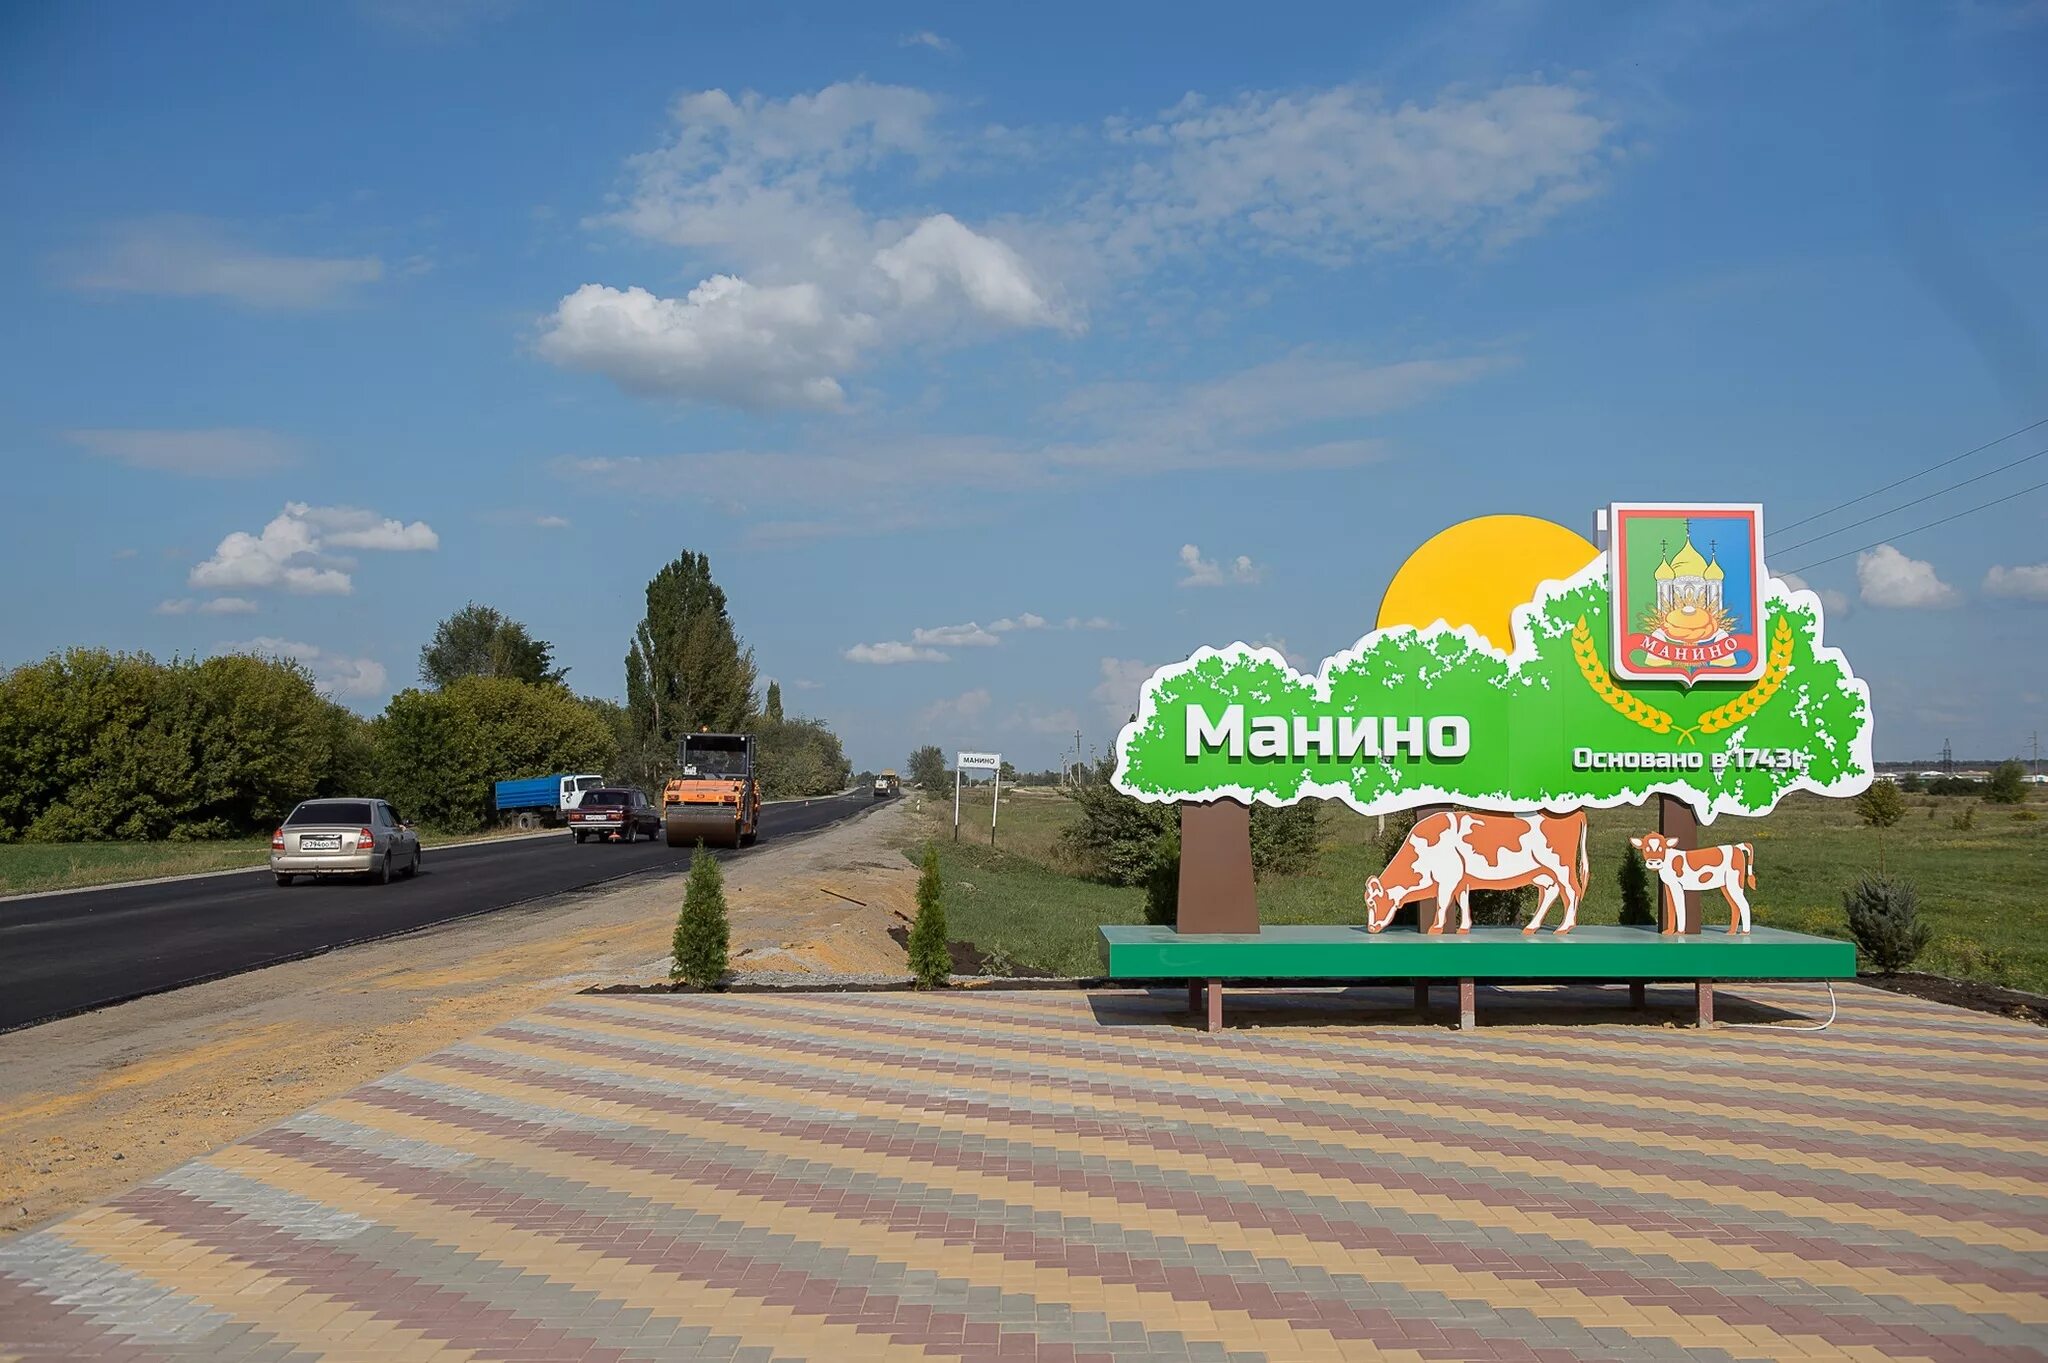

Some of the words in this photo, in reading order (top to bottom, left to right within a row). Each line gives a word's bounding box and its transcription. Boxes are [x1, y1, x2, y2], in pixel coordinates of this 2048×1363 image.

[1640, 636, 1738, 660] МАНИНО
[1185, 704, 1470, 757] Манино
[1573, 747, 1703, 768] Основано
[1712, 753, 1727, 768] в
